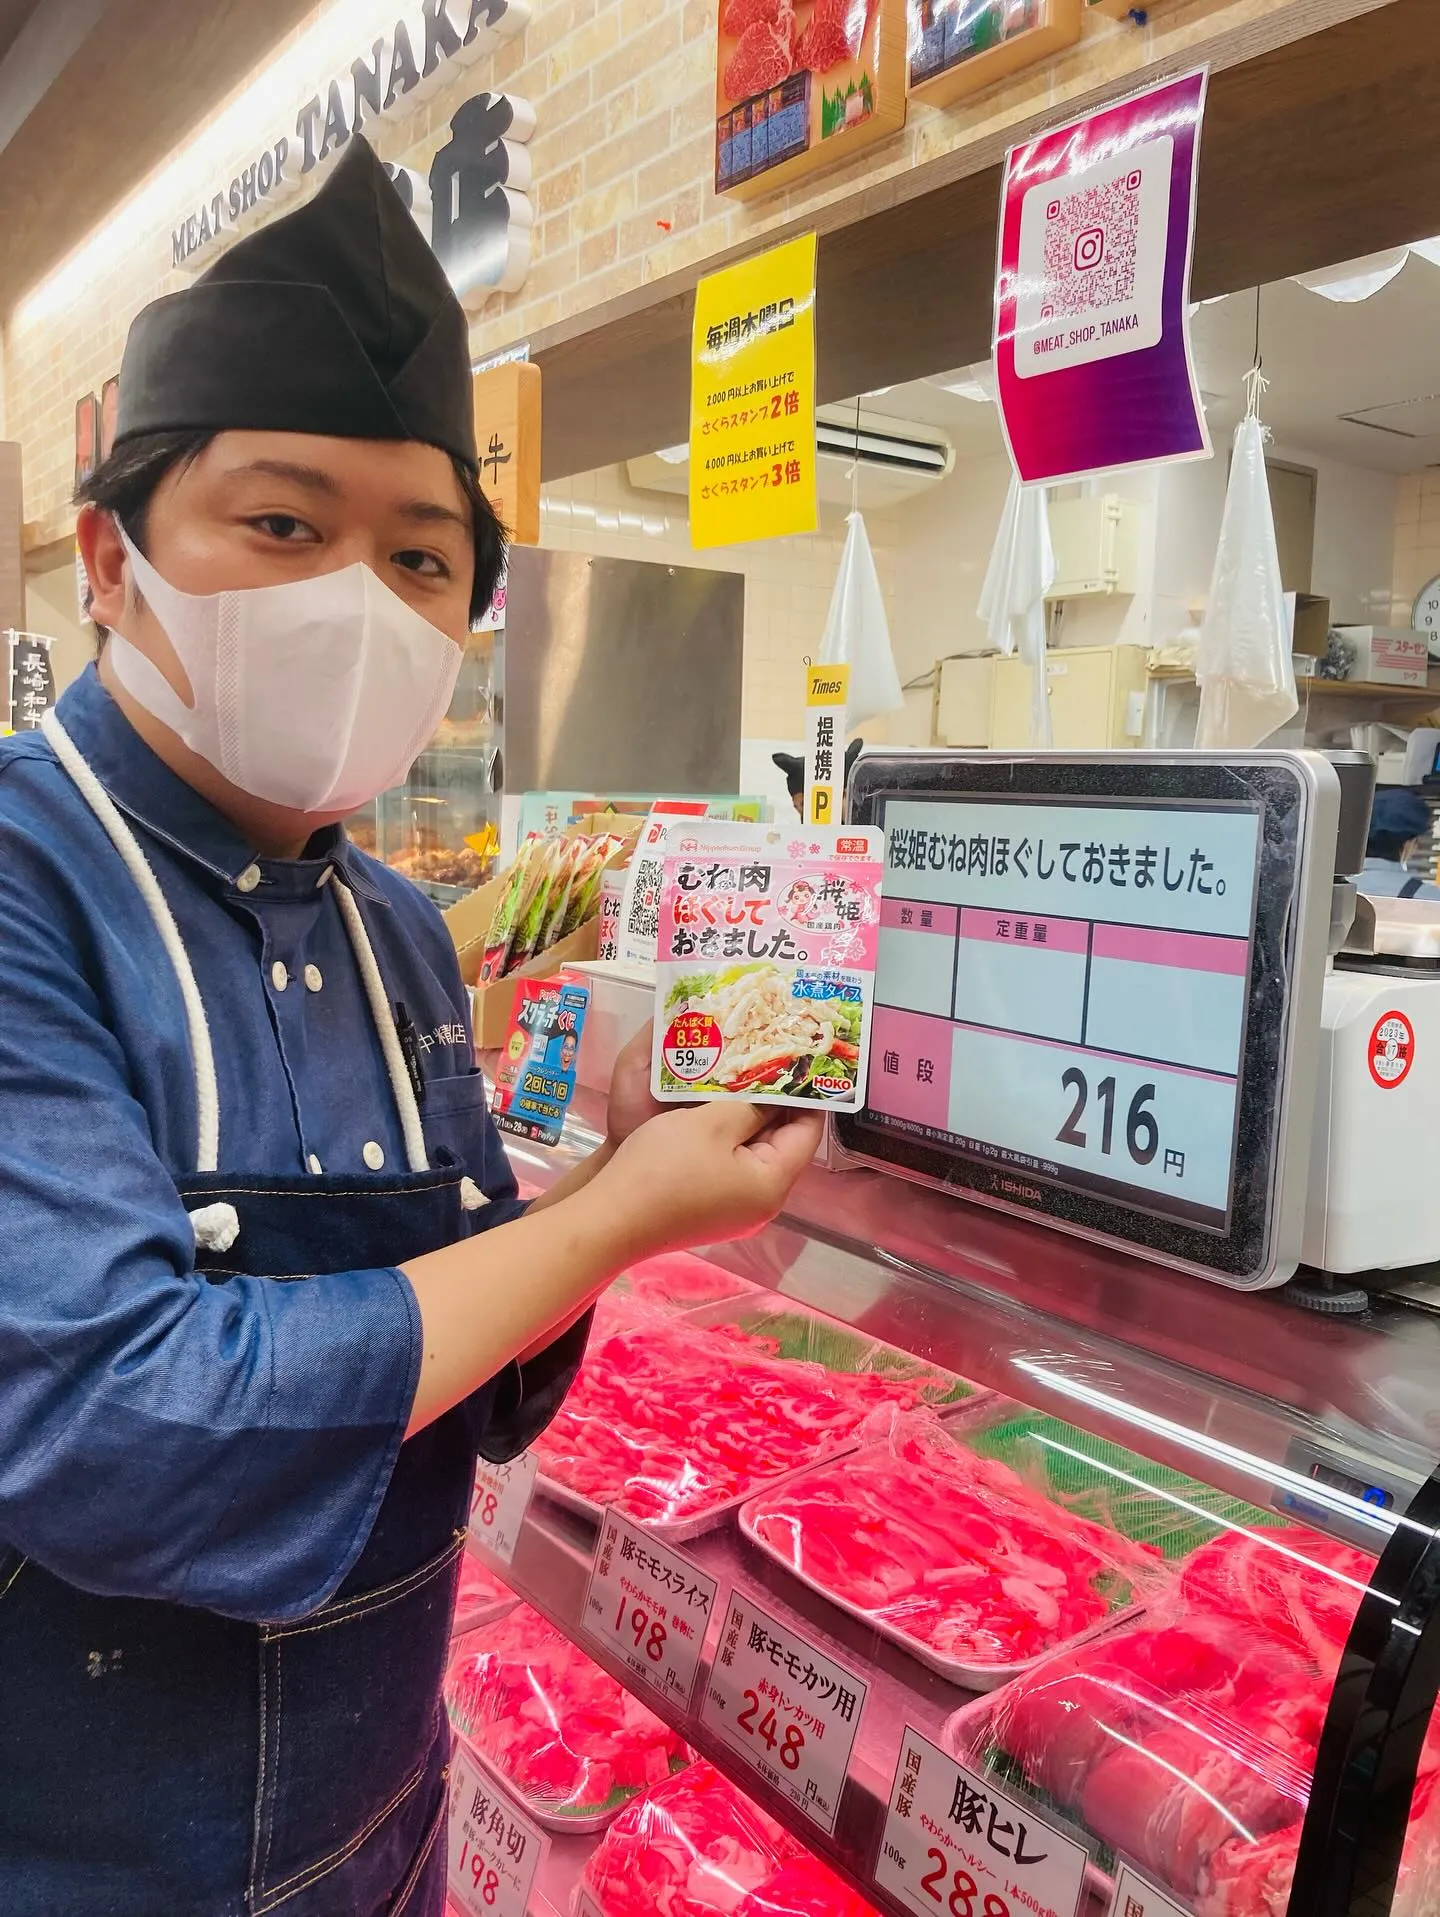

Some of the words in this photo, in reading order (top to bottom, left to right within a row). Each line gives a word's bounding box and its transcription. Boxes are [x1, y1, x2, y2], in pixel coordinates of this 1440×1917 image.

[171, 192, 225, 268] MEAT
[228, 137, 288, 222] SHOP
[296, 0, 509, 174] TANAKA
[706, 297, 795, 351] 毎週木曜日
[1033, 313, 1139, 355] @MEAT_SHOP_TANAKA
[1425, 616, 1433, 627] 9
[1428, 600, 1439, 611] 10
[1430, 631, 1438, 641] 8
[22, 652, 50, 729] 長崎和牛
[811, 678, 842, 695] Times
[840, 839, 866, 853] 常温
[889, 827, 1226, 896] 桜姫むね肉ほぐしておきました。
[677, 862, 771, 893] むね肉
[674, 896, 771, 926] ほぐして
[996, 919, 1047, 943] 定重量
[672, 928, 808, 961] おきました。
[676, 1028, 709, 1047] 8.3g
[1379, 1027, 1405, 1040] 2023年
[675, 1049, 709, 1067] 59kcal
[814, 1076, 851, 1091] HOKO
[1056, 1067, 1159, 1166] 216
[1163, 1148, 1185, 1178] 円
[1001, 1179, 1042, 1200] ISHIDA
[598, 1524, 618, 1578] 国産豚
[619, 1535, 710, 1616] 豚モモスライス
[615, 1596, 668, 1662] 198
[720, 1607, 744, 1667] 国産豚
[746, 1621, 857, 1723] 豚モモカツ用
[736, 1688, 806, 1771] 248
[757, 1677, 826, 1740] 赤身トンカツ用
[895, 1747, 922, 1819] 国産豚
[469, 1785, 527, 1864] 豚角切
[947, 1774, 1048, 1865] 豚ヒレ
[459, 1840, 499, 1905] 198
[882, 1840, 907, 1870] 100g
